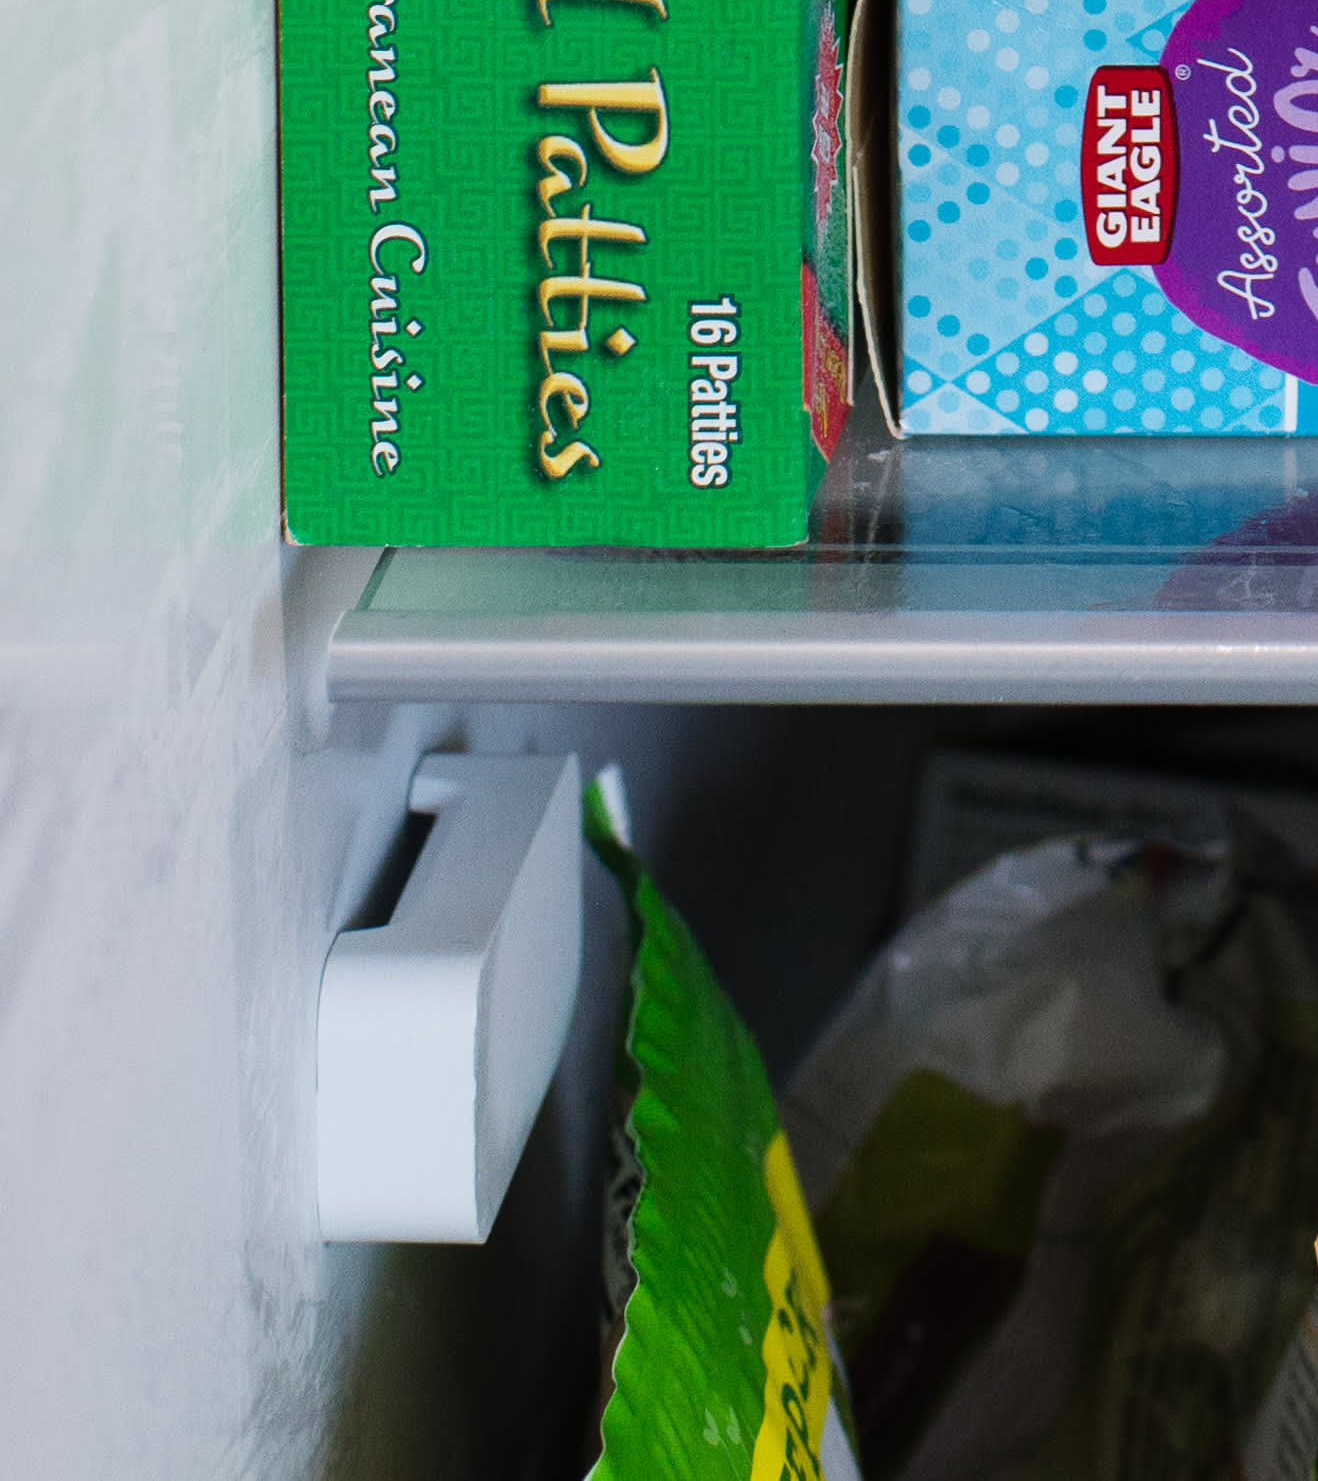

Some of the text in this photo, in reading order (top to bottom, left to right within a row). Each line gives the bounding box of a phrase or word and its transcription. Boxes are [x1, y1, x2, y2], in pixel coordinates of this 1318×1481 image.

[536, 66, 674, 481] Patties
[1095, 84, 1129, 250] GIANT
[1129, 87, 1163, 245] EAGLE
[1196, 46, 1279, 322] Assorted
[367, 222, 428, 479] Cuisine
[688, 295, 741, 490] 16 Patties
